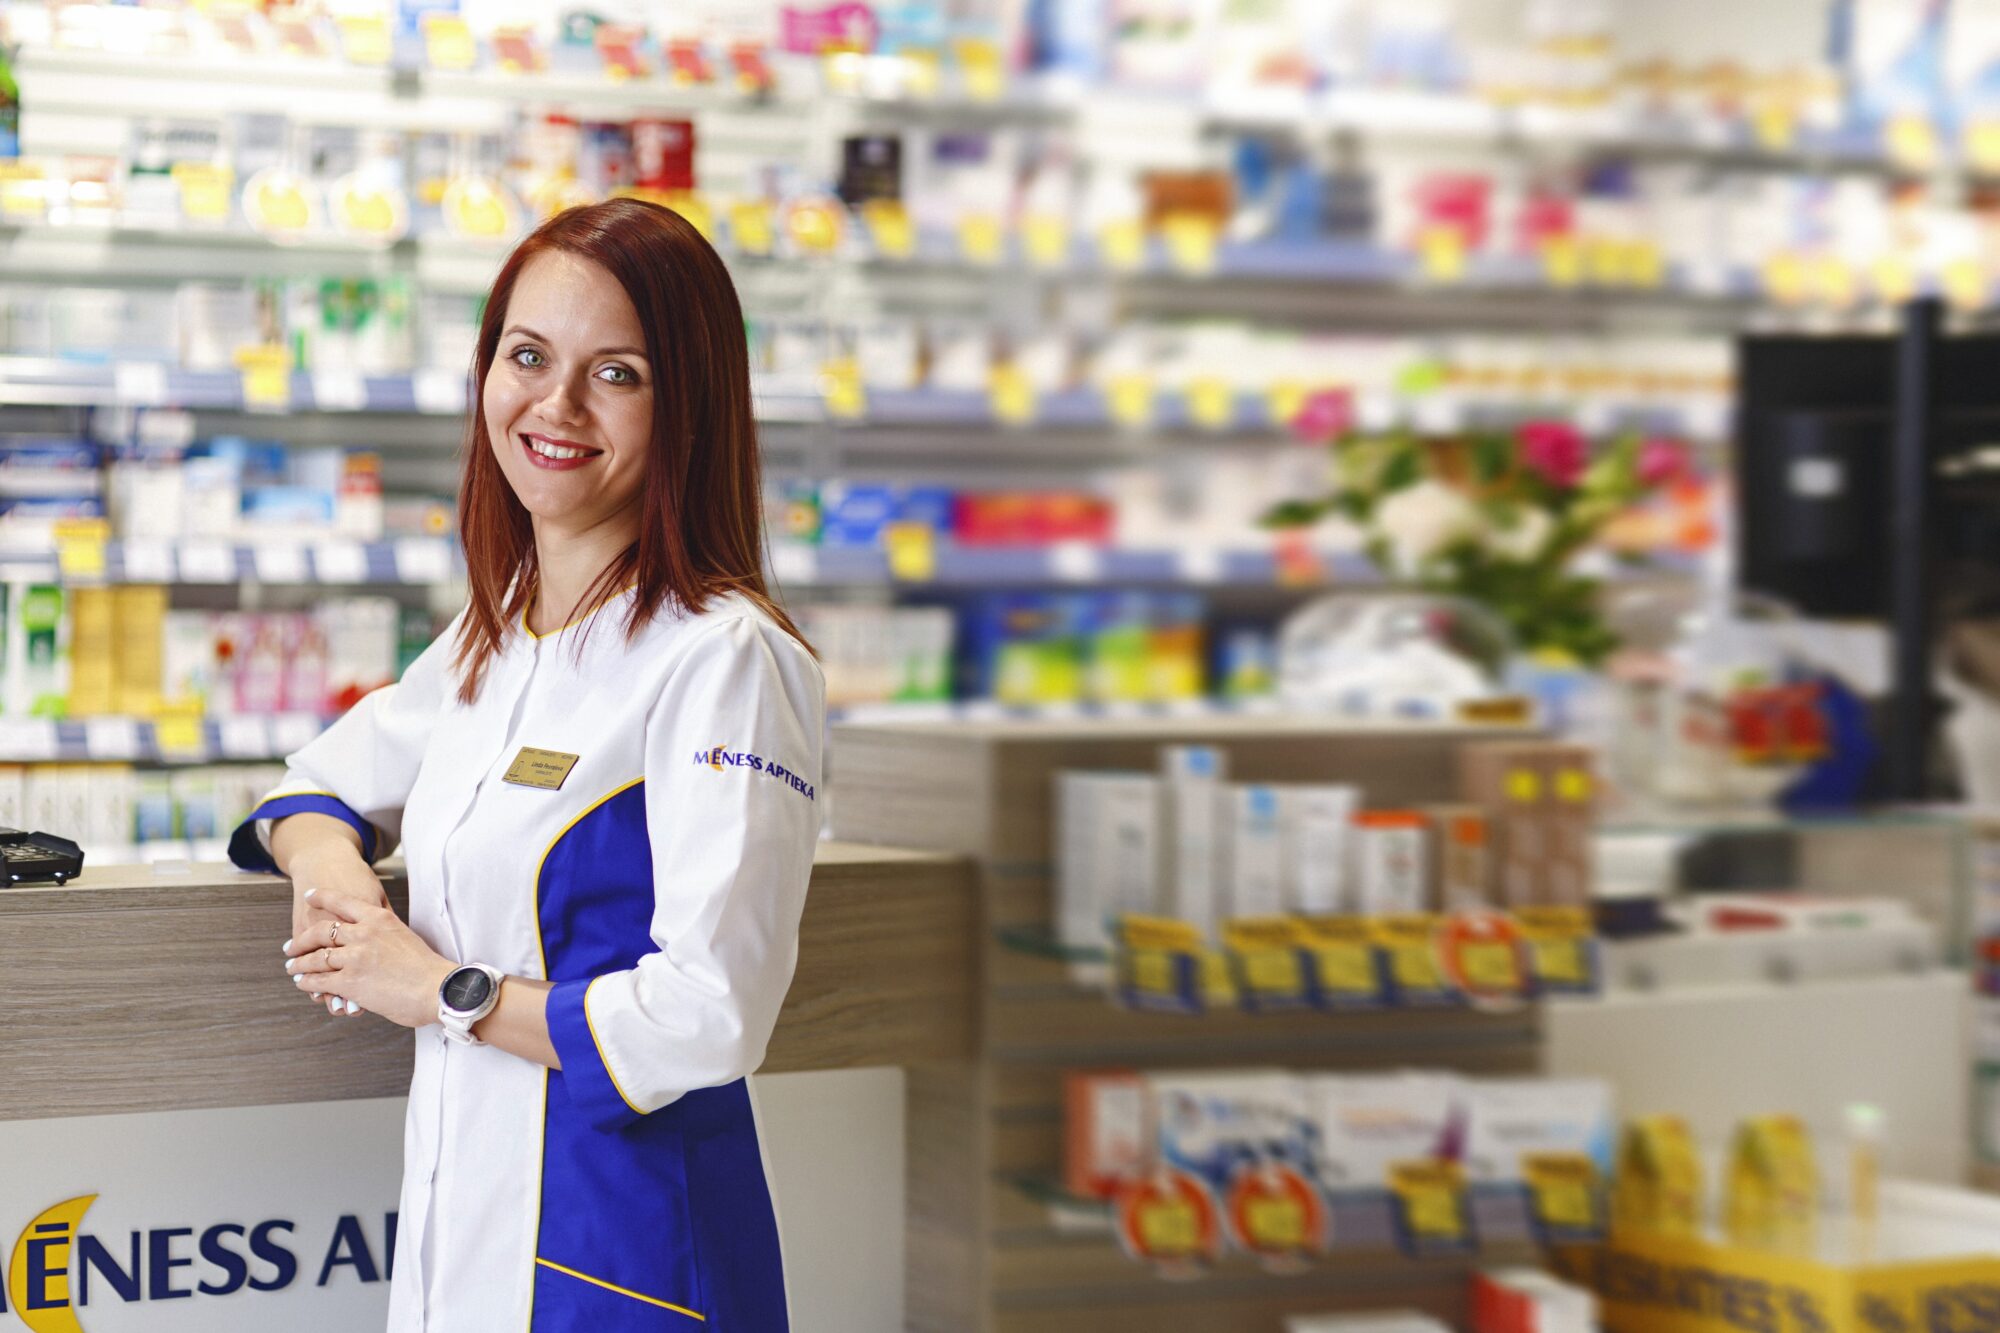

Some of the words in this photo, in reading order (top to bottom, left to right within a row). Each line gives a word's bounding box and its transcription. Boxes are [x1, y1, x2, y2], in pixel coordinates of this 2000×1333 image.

[693, 747, 763, 771] MĒNESS
[765, 761, 815, 801] APTIEKA
[0, 1219, 298, 1313] ĒNESS
